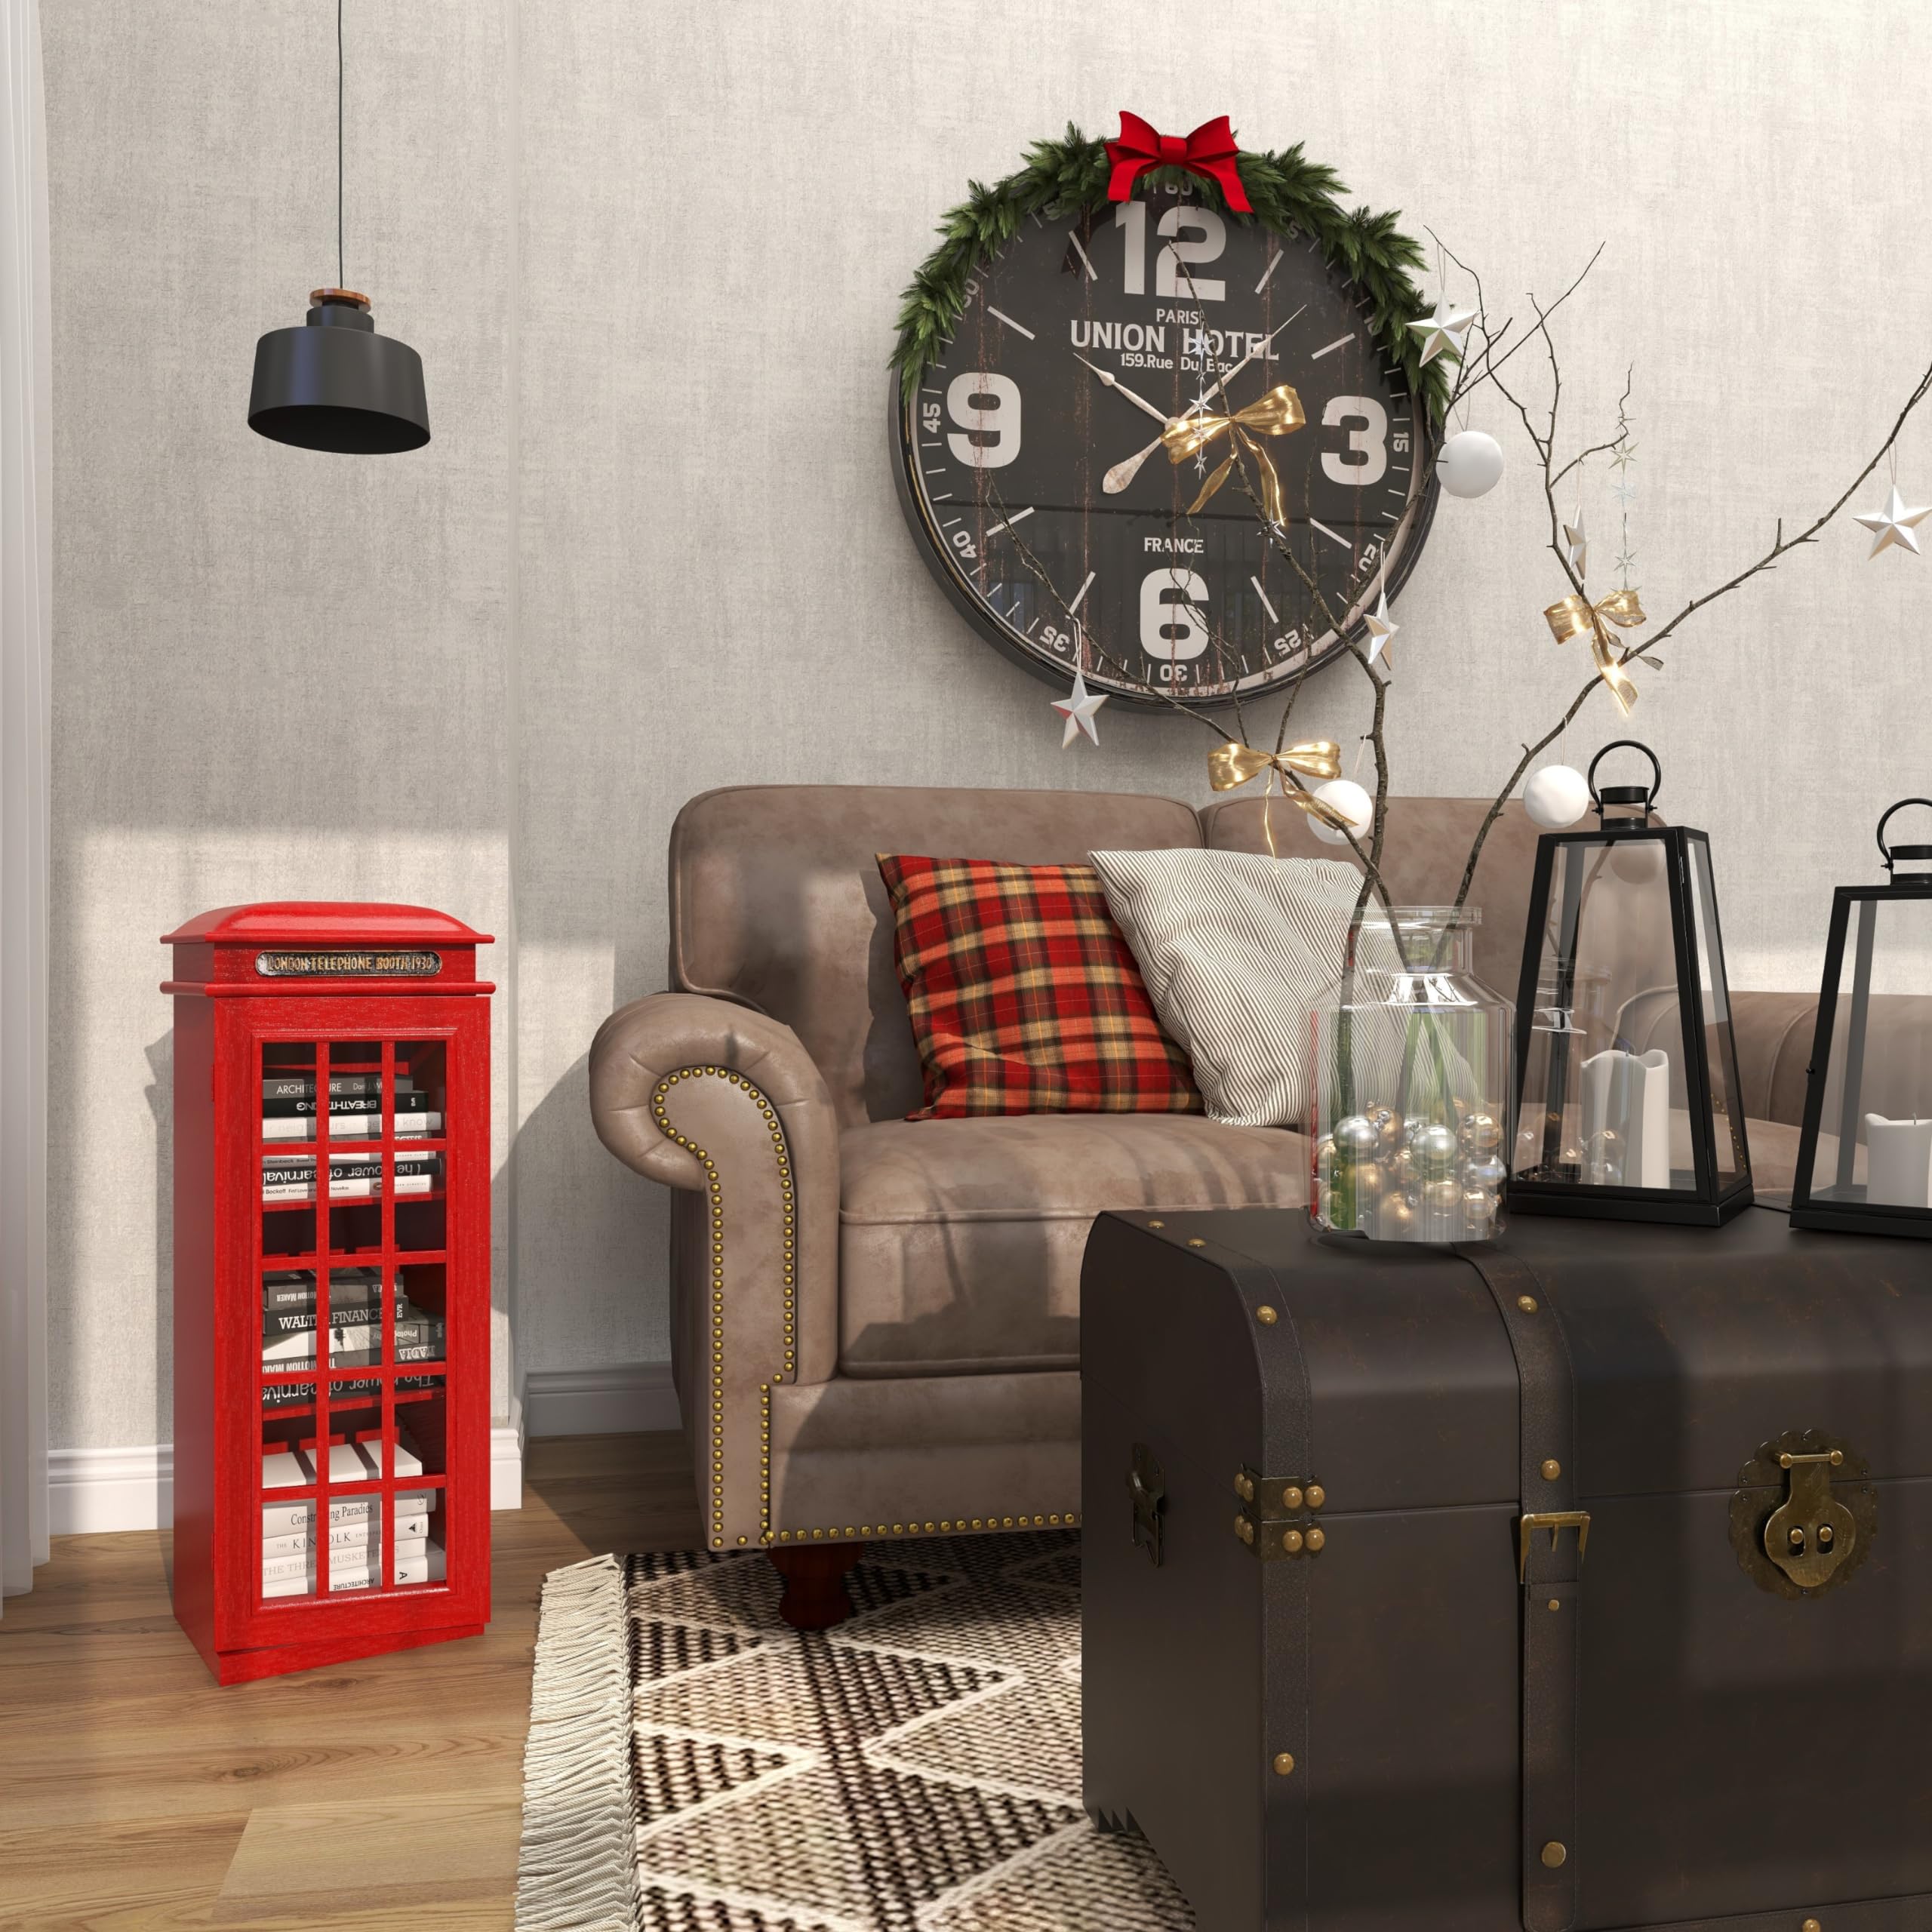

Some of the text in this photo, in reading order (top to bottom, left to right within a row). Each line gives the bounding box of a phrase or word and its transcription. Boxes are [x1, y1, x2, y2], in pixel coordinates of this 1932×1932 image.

[1115, 200, 1226, 301] 12
[1155, 308, 1199, 325] PARIS
[1070, 319, 1279, 361] UNION HOTEL
[1121, 352, 1174, 370] 159.Rue
[1180, 356, 1198, 371] Du
[922, 402, 941, 433] 45
[947, 372, 1021, 469] 9
[1321, 395, 1388, 486] 3
[1392, 431, 1410, 453] 15
[952, 530, 977, 559] 40
[1143, 537, 1204, 554] FRANCE
[1140, 568, 1210, 660] 6
[1039, 626, 1070, 652] 35
[1273, 629, 1301, 657] 25
[1159, 664, 1188, 681] 30
[267, 955, 433, 971] LONDON TELEPHONE BOOTH 1930
[342, 1503, 374, 1518] Paradies
[263, 1565, 285, 1576] THE
[287, 1560, 317, 1572] THRE
[333, 1577, 375, 1591] ARCHITECTURE
